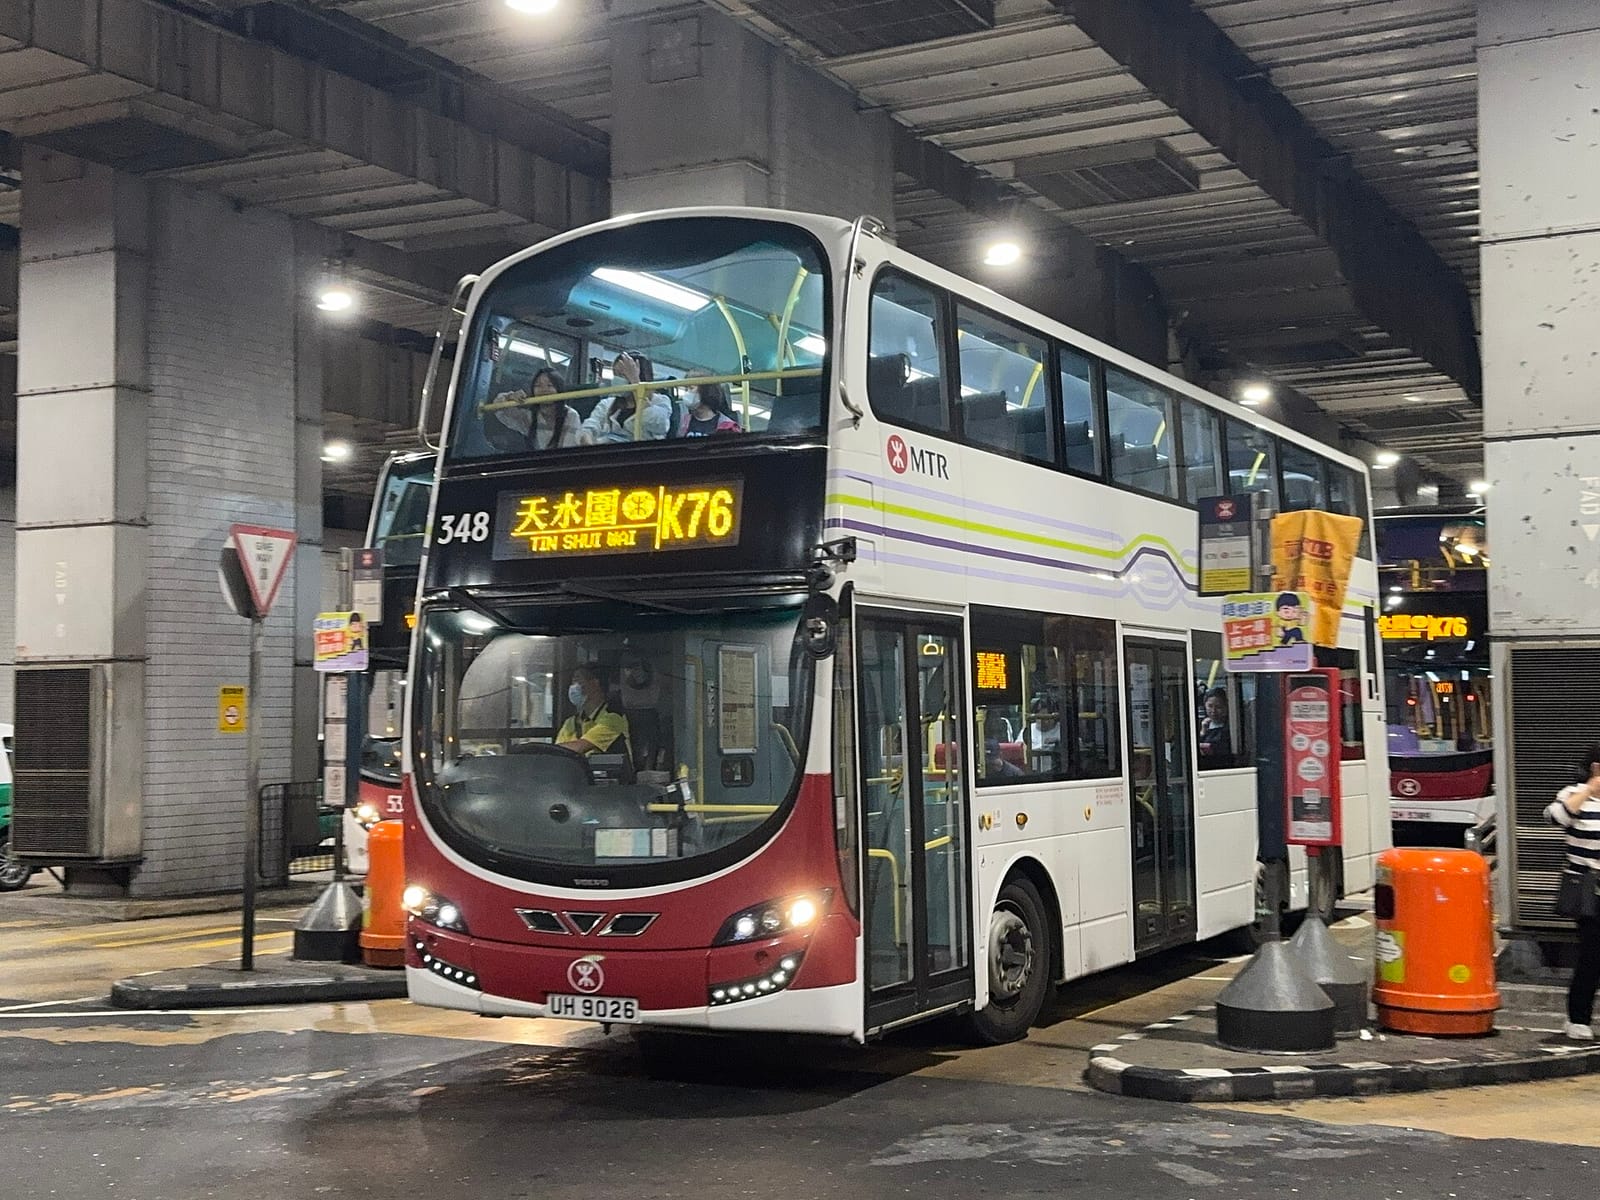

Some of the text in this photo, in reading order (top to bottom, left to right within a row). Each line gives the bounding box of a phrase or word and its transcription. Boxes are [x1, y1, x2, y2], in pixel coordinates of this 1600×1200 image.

[910, 446, 949, 480] MTR
[514, 489, 621, 532] 天水圍
[662, 489, 733, 539] K76
[437, 511, 490, 545] 348
[530, 530, 637, 551] TIN SHUI WAI
[1430, 616, 1467, 637] K76
[551, 997, 634, 1019] UH 9026
